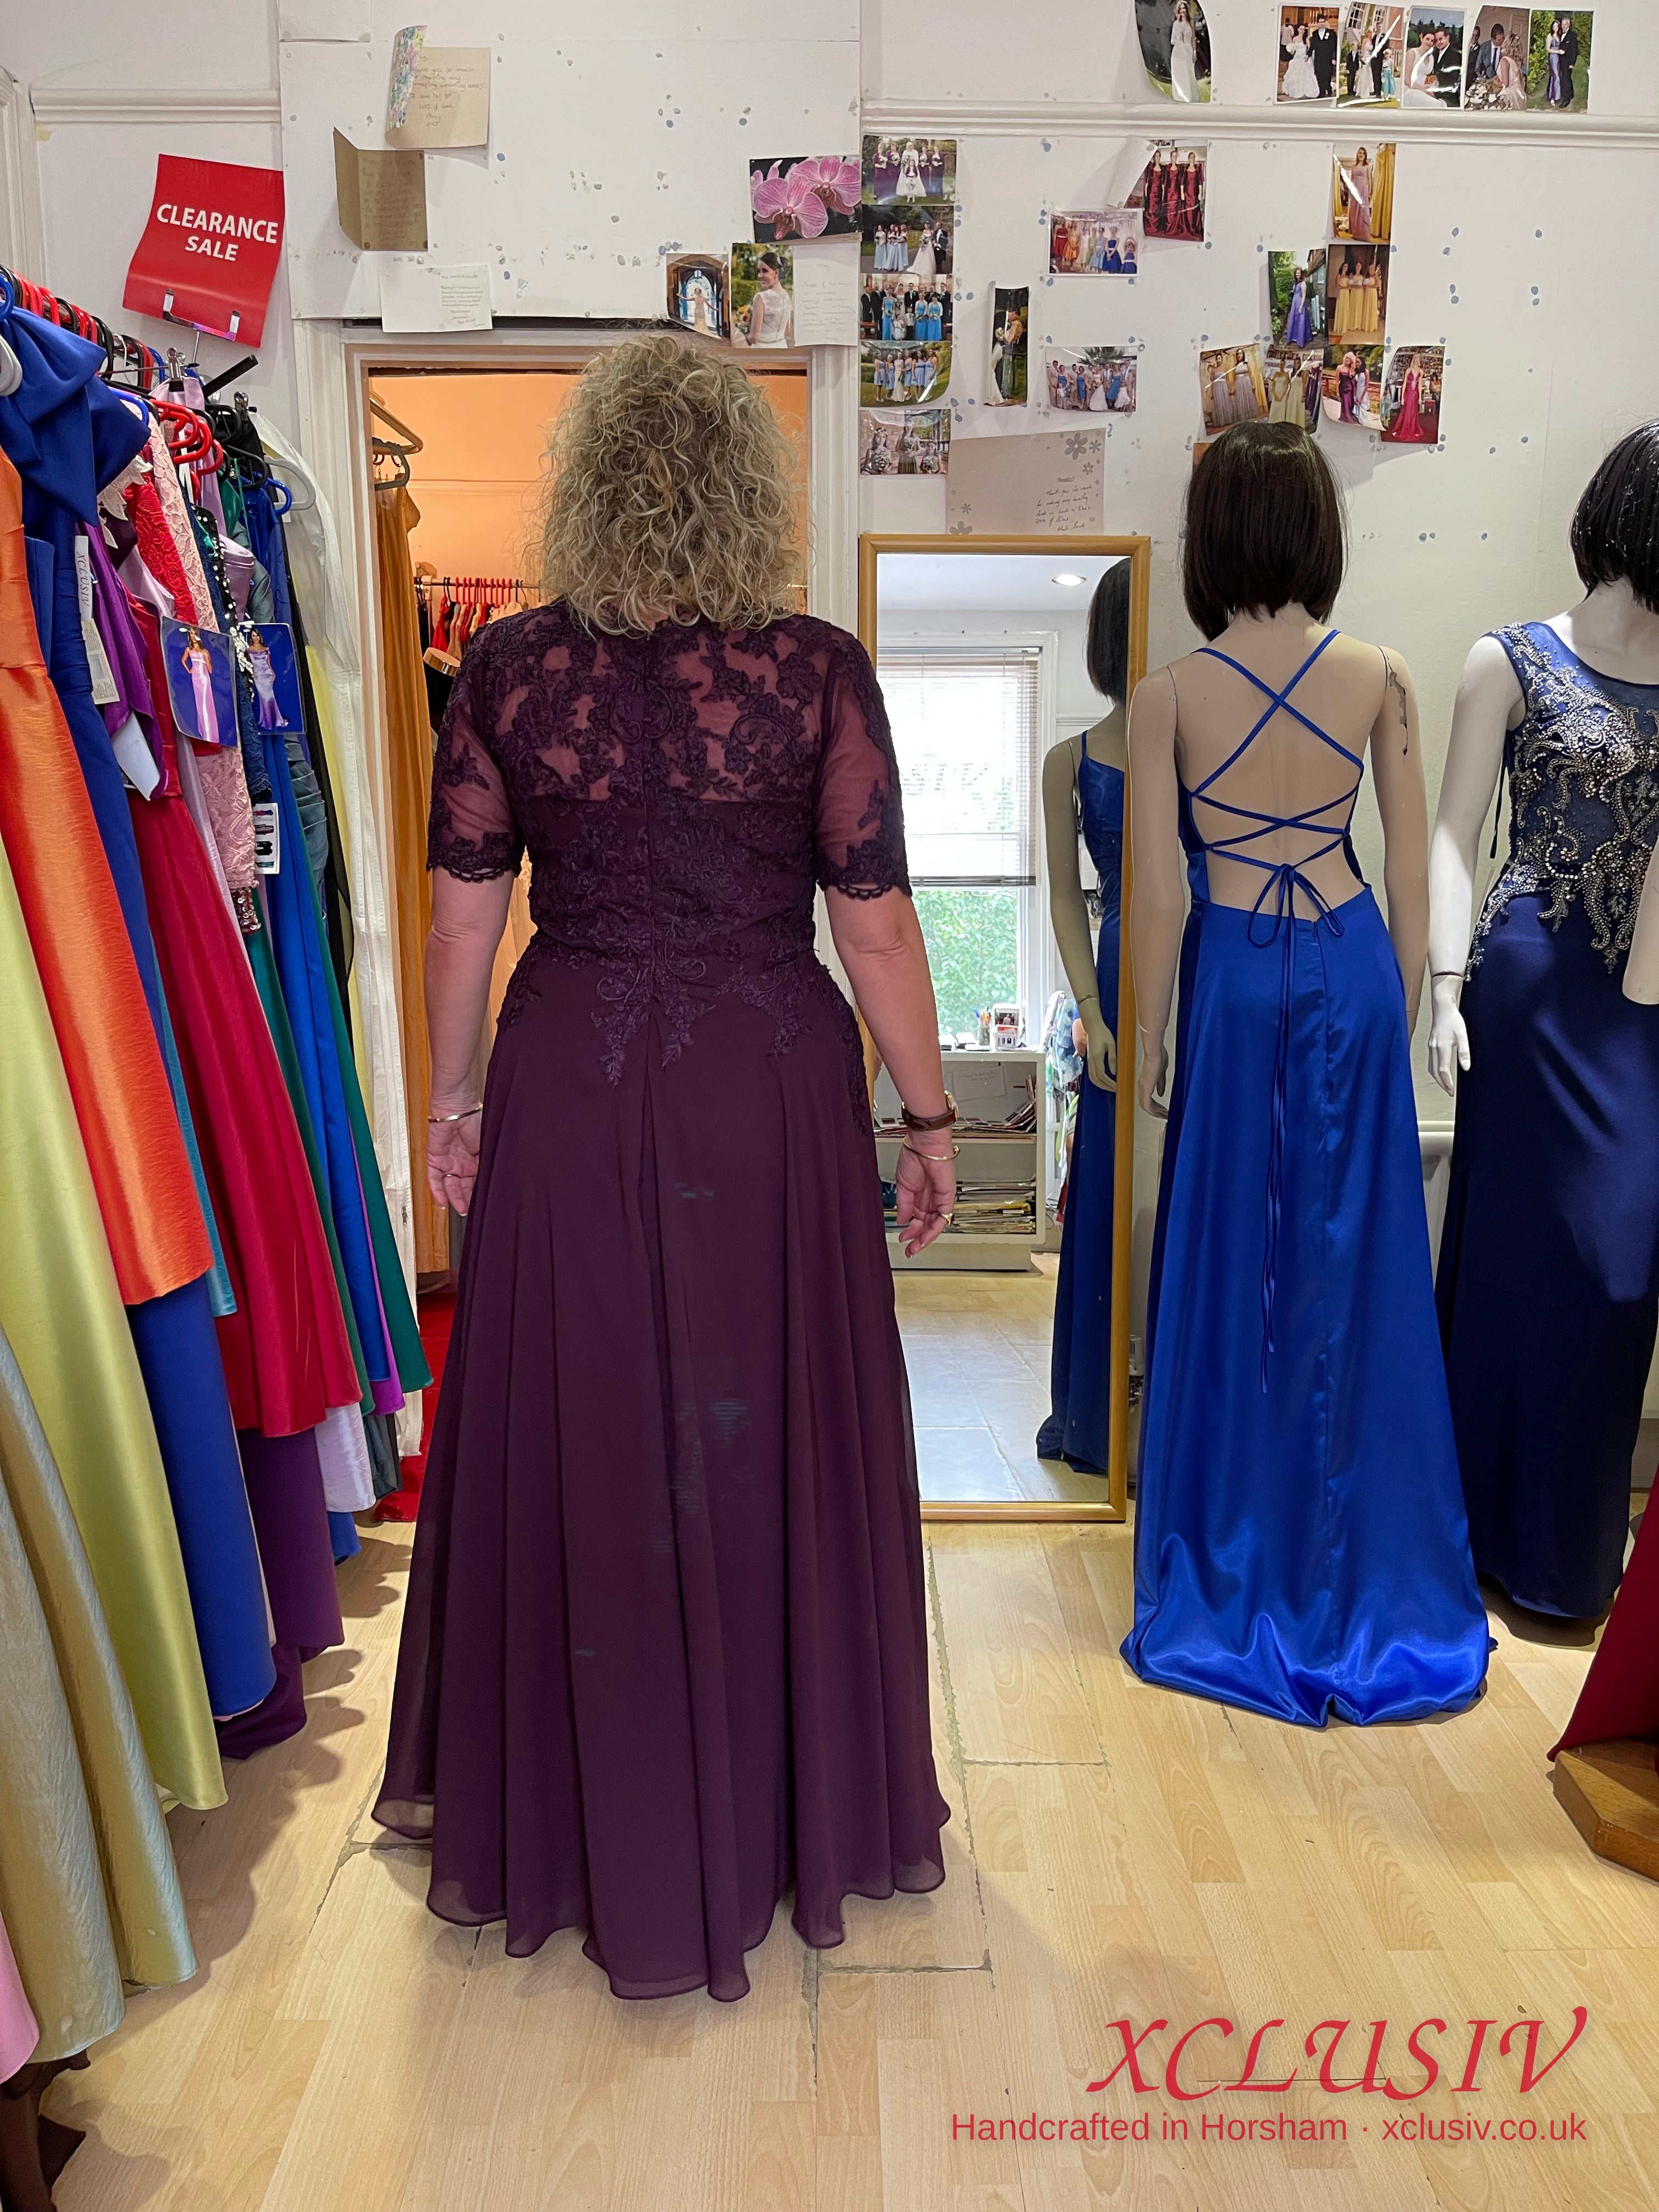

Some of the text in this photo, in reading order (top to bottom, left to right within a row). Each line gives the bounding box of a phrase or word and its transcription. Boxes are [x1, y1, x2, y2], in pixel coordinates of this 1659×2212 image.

[156, 204, 278, 244] CLEARANCE
[185, 236, 239, 262] SALE
[76, 551, 91, 607] XCLUSIV
